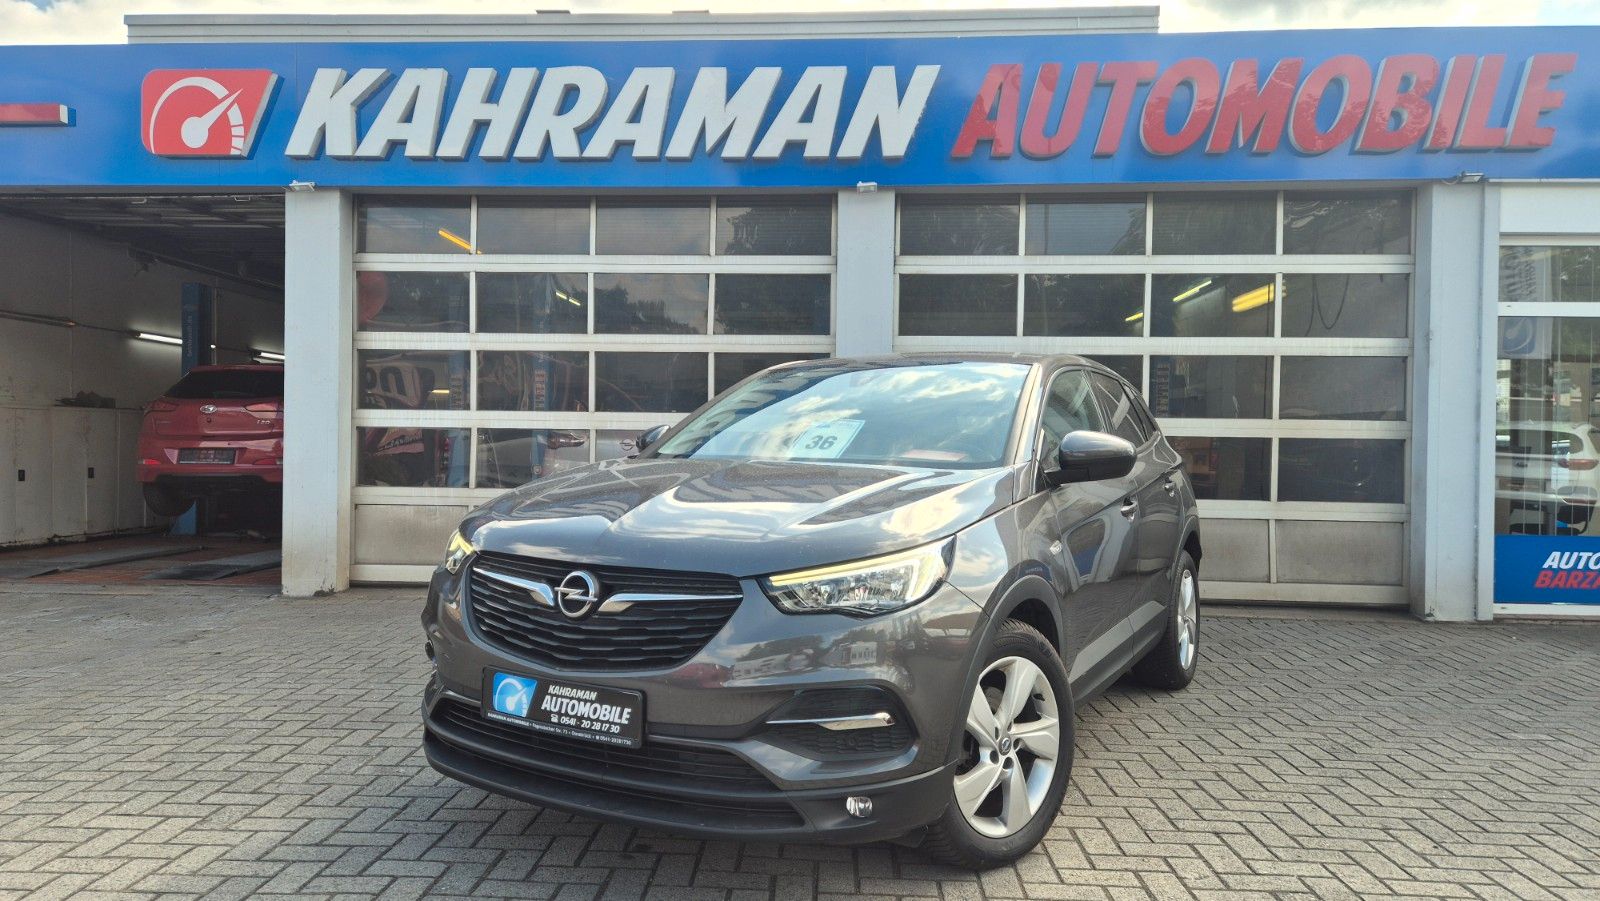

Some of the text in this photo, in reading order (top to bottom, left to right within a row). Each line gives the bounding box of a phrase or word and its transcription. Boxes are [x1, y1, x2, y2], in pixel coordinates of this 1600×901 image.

[284, 53, 1578, 160] KAHRAMAN AUTOMOBILE
[805, 435, 837, 449] 36
[548, 685, 598, 700] KAHRAMAN
[541, 695, 631, 724] AUTOMOBILE
[560, 716, 577, 726] 0541
[581, 719, 591, 729] 20
[591, 721, 601, 730] 28
[601, 723, 609, 731] 17
[610, 725, 620, 734] 30
